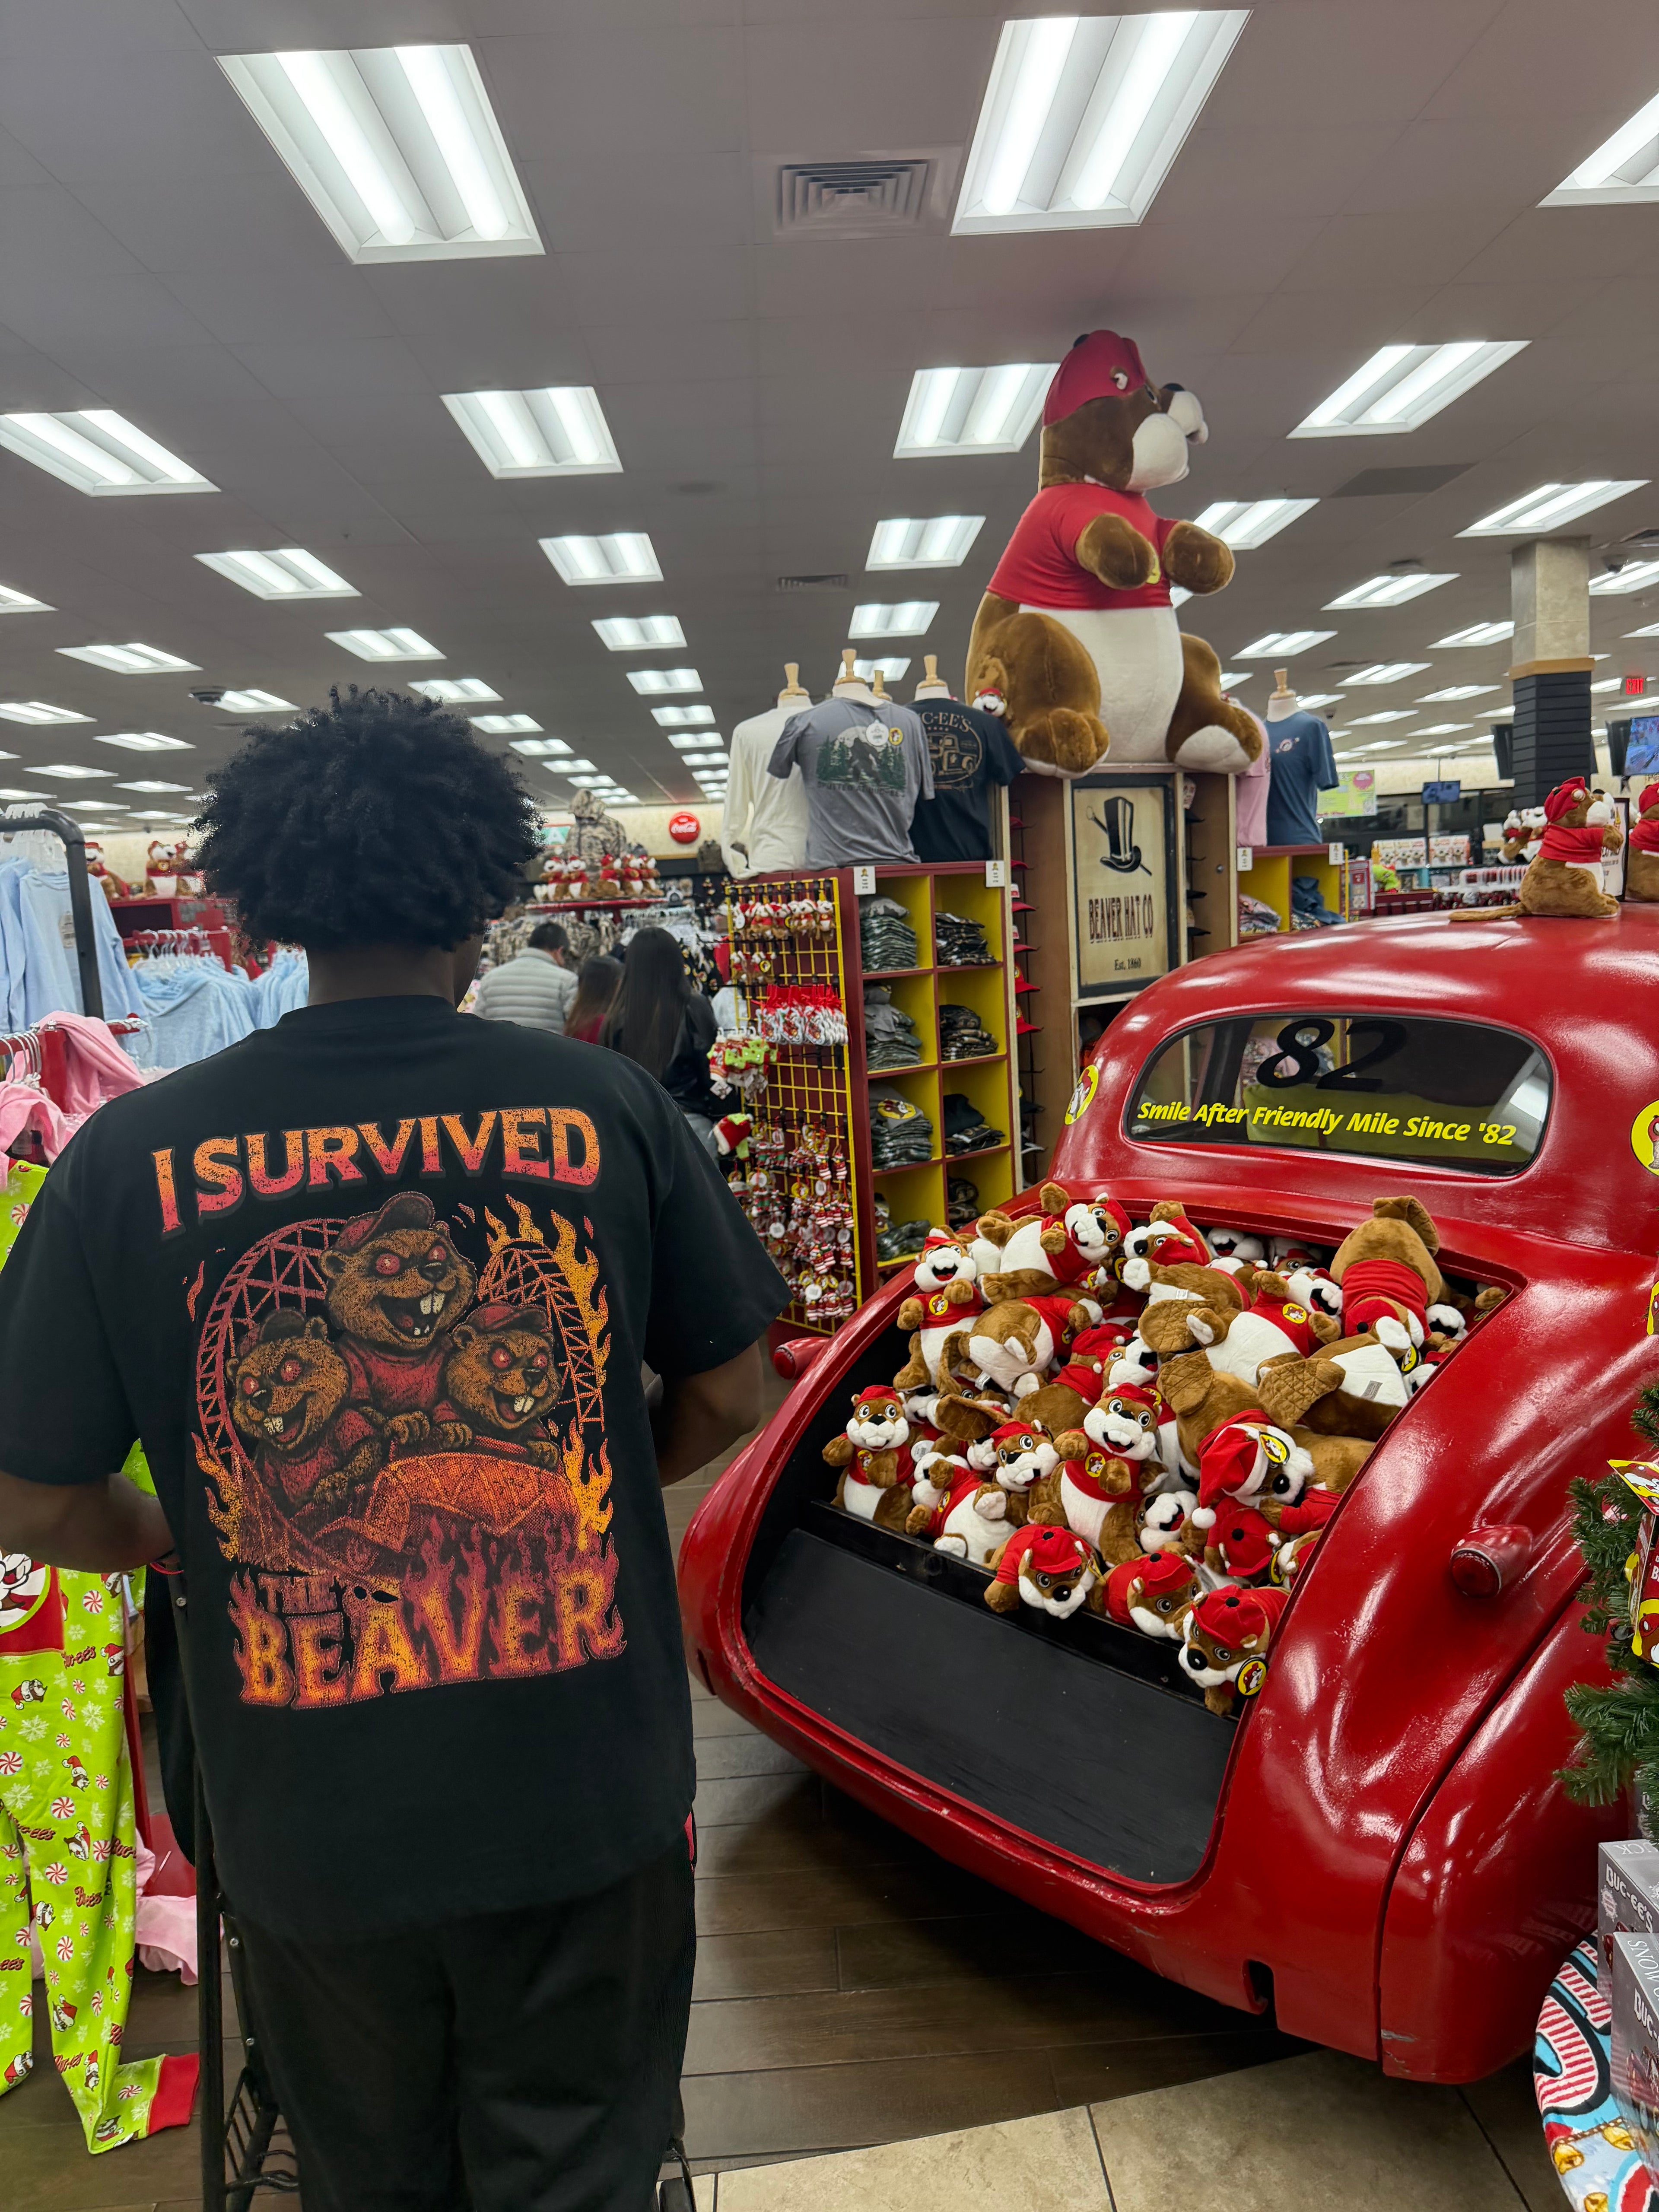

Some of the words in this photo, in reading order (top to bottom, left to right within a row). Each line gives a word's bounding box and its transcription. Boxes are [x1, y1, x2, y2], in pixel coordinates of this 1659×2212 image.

[1626, 677, 1643, 695] EXIT
[921, 712, 972, 733] C-EE'S
[1088, 897, 1123, 944] BEAVER
[1124, 895, 1140, 940] HAT
[1143, 893, 1153, 938] CO
[1256, 1018, 1406, 1091] 82
[1137, 1101, 1191, 1121] Smile
[1192, 1103, 1249, 1127] After
[1252, 1105, 1344, 1135] Friendly
[1346, 1112, 1399, 1135] Mile
[1403, 1116, 1471, 1141] Since
[1479, 1122, 1517, 1146] '82
[151, 1147, 183, 1236] I
[193, 1107, 601, 1218] SURVIVED
[257, 1573, 338, 1614] THE
[230, 1569, 626, 1710] BEAVER
[1634, 1987, 1659, 2050] BUC-
